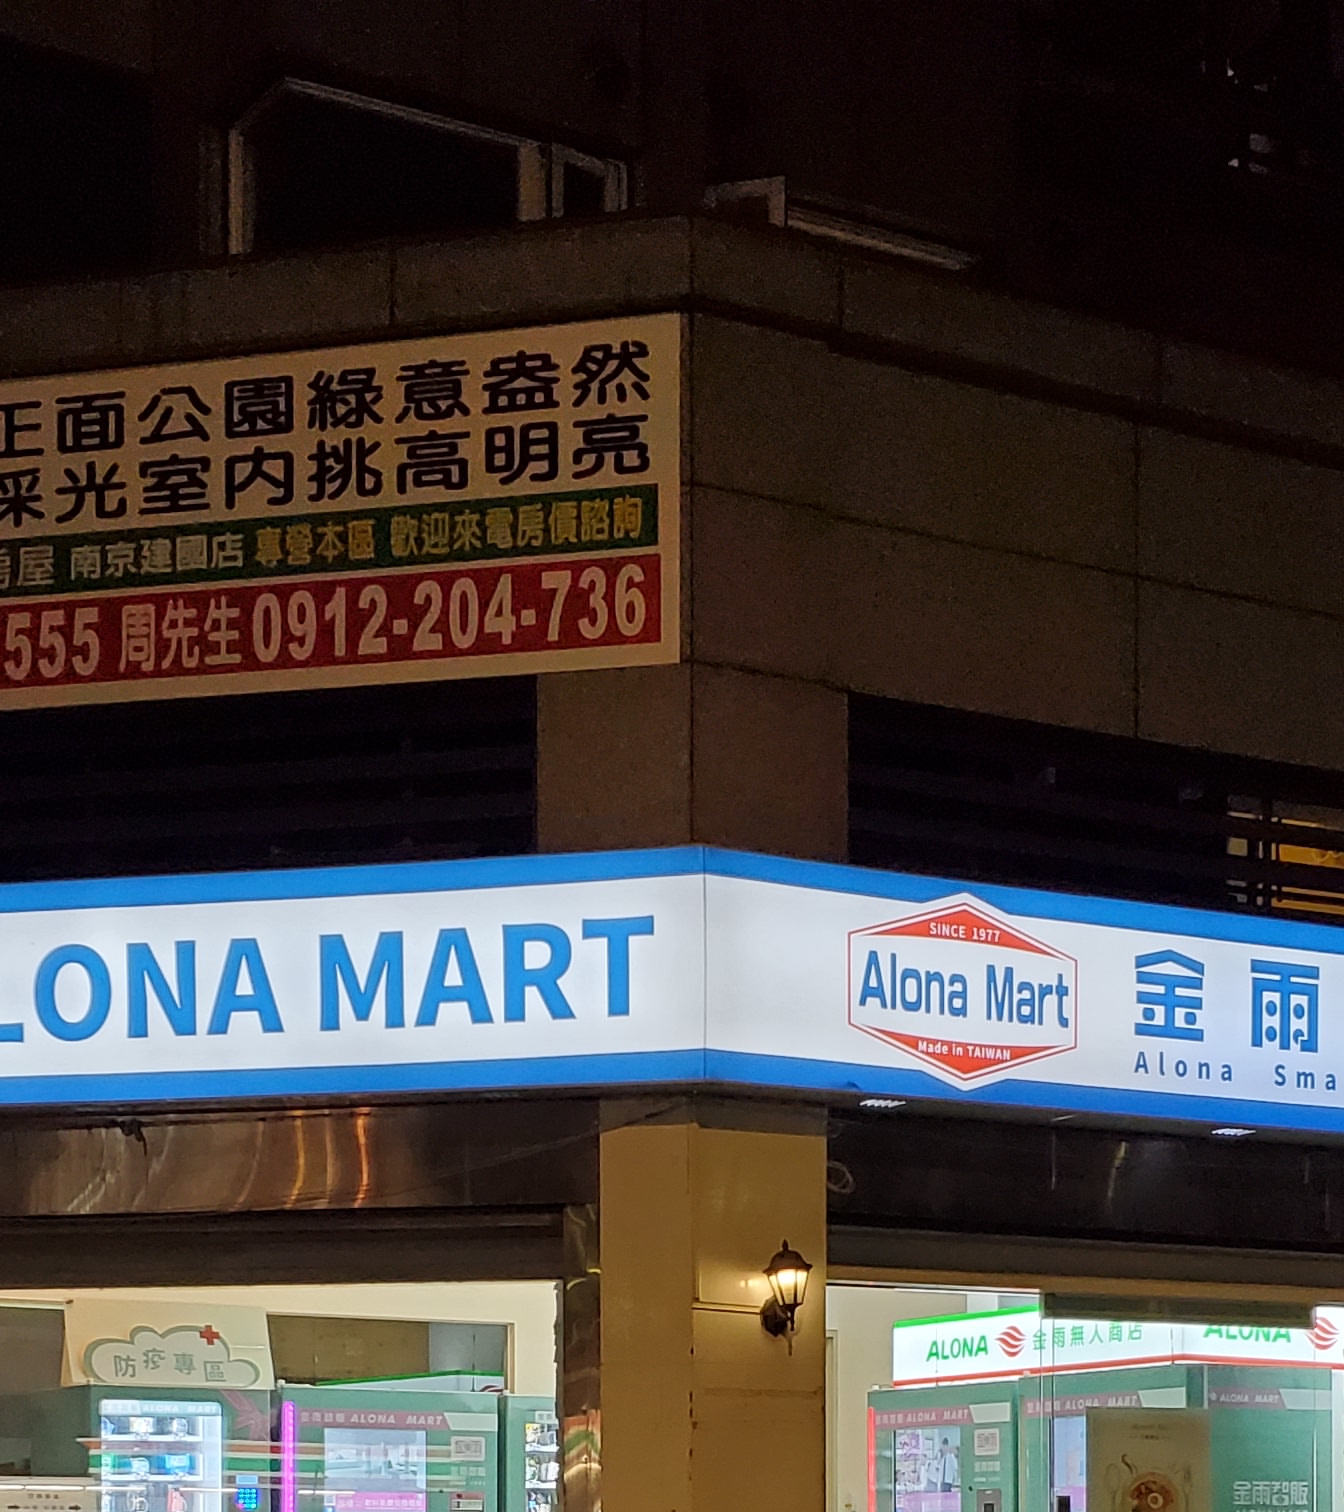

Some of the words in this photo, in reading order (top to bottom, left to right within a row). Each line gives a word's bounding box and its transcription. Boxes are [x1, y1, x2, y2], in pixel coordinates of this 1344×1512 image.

[69, 532, 245, 582] 南京建國店
[119, 594, 243, 674] 周先生
[254, 562, 646, 664] 0912-204-736
[929, 922, 967, 939] SINCE
[972, 927, 1001, 942] 1977
[318, 914, 655, 1033] MART
[859, 950, 968, 1018] Alona
[986, 964, 1069, 1029] Mart
[918, 1040, 949, 1055] Made
[952, 1041, 964, 1056] in
[966, 1045, 1011, 1060] TAIWAN
[1134, 1051, 1233, 1084] Alona
[113, 1348, 227, 1382] 防疫專區
[926, 1335, 988, 1362] ALONA
[350, 1415, 396, 1425] ALONA
[406, 1415, 443, 1426] MART
[906, 1411, 937, 1423] ALONA
[943, 1409, 969, 1421] MART
